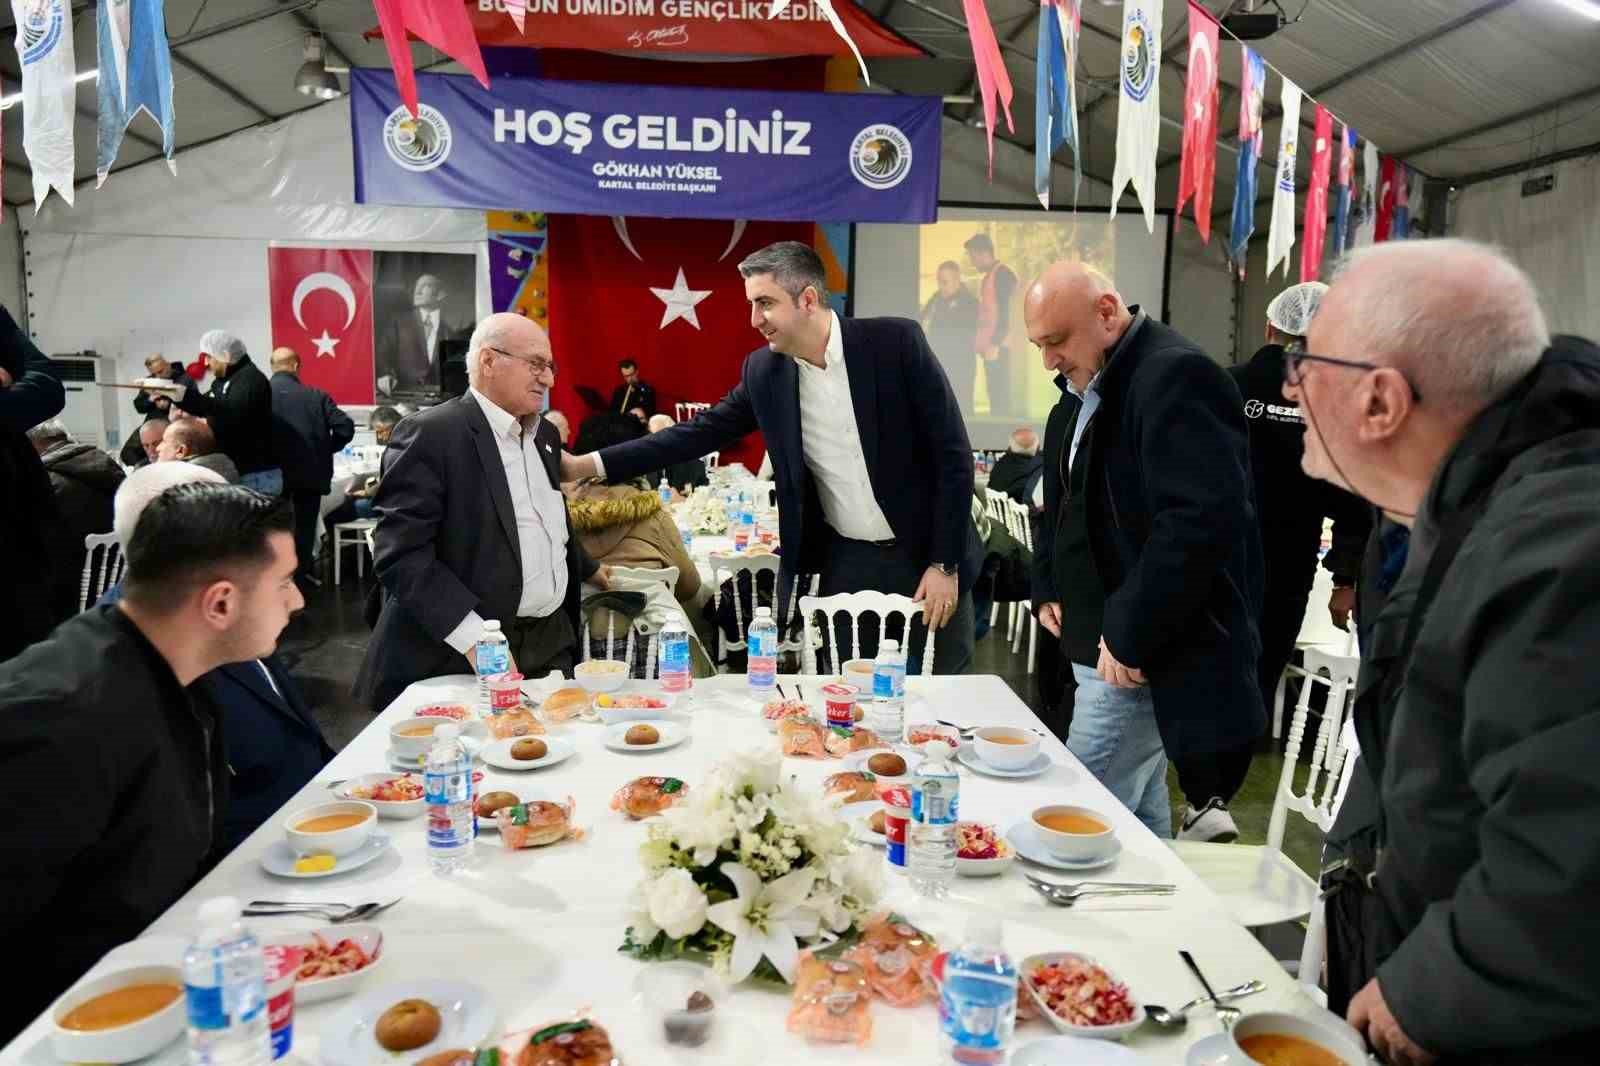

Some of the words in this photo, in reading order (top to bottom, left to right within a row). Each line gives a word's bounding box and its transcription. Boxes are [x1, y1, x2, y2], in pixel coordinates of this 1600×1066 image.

[494, 108, 593, 154] HOŞ
[602, 107, 811, 155] GELDİNİZ
[592, 160, 662, 178] GÖKHAN
[665, 163, 722, 180] YÜKSEL
[598, 180, 633, 189] KARTAL
[635, 181, 676, 191] BELEDİYE
[677, 183, 716, 194] BAŞKANI
